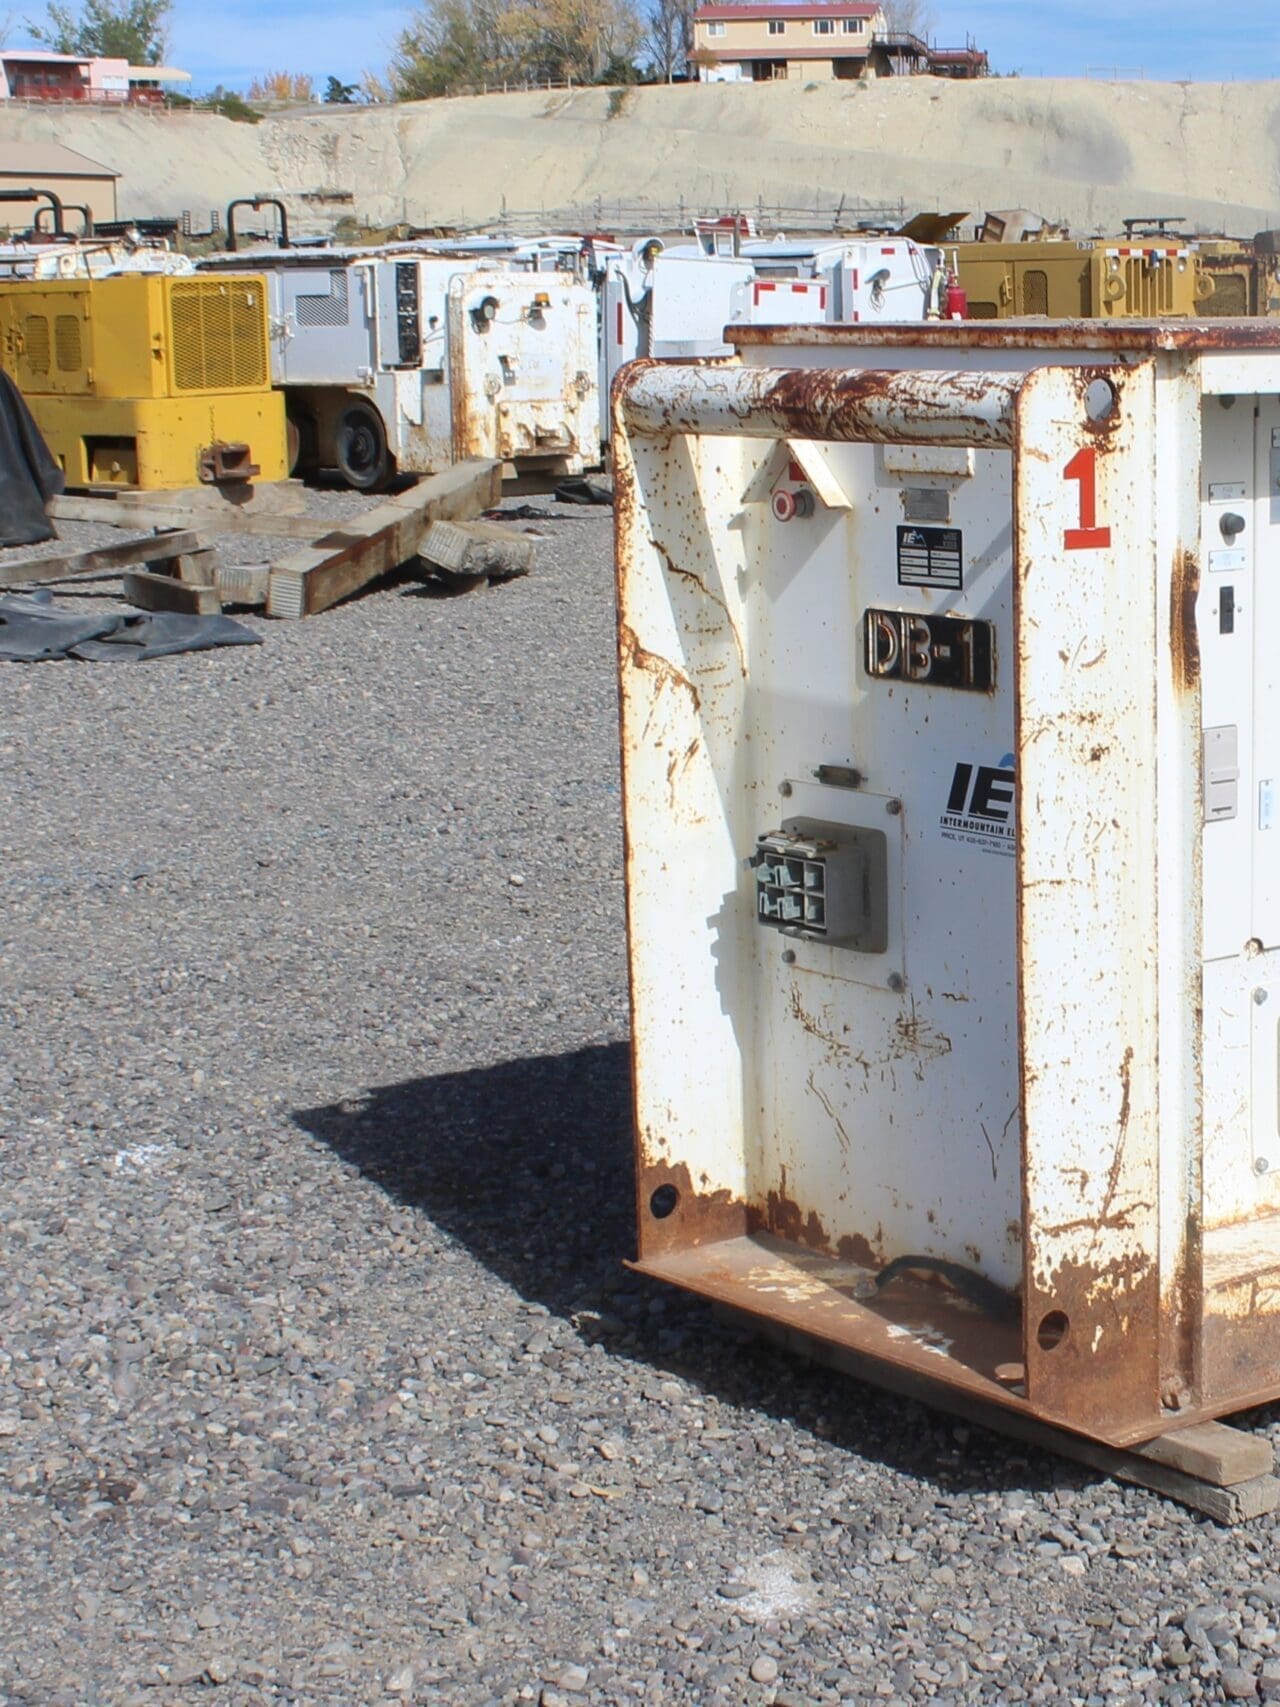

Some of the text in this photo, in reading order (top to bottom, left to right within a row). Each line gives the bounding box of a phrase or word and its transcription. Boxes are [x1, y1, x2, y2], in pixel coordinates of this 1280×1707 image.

[1063, 448, 1111, 550] 1
[868, 612, 974, 684] DB-1
[940, 816, 1004, 835] INTERMOUNTAIN
